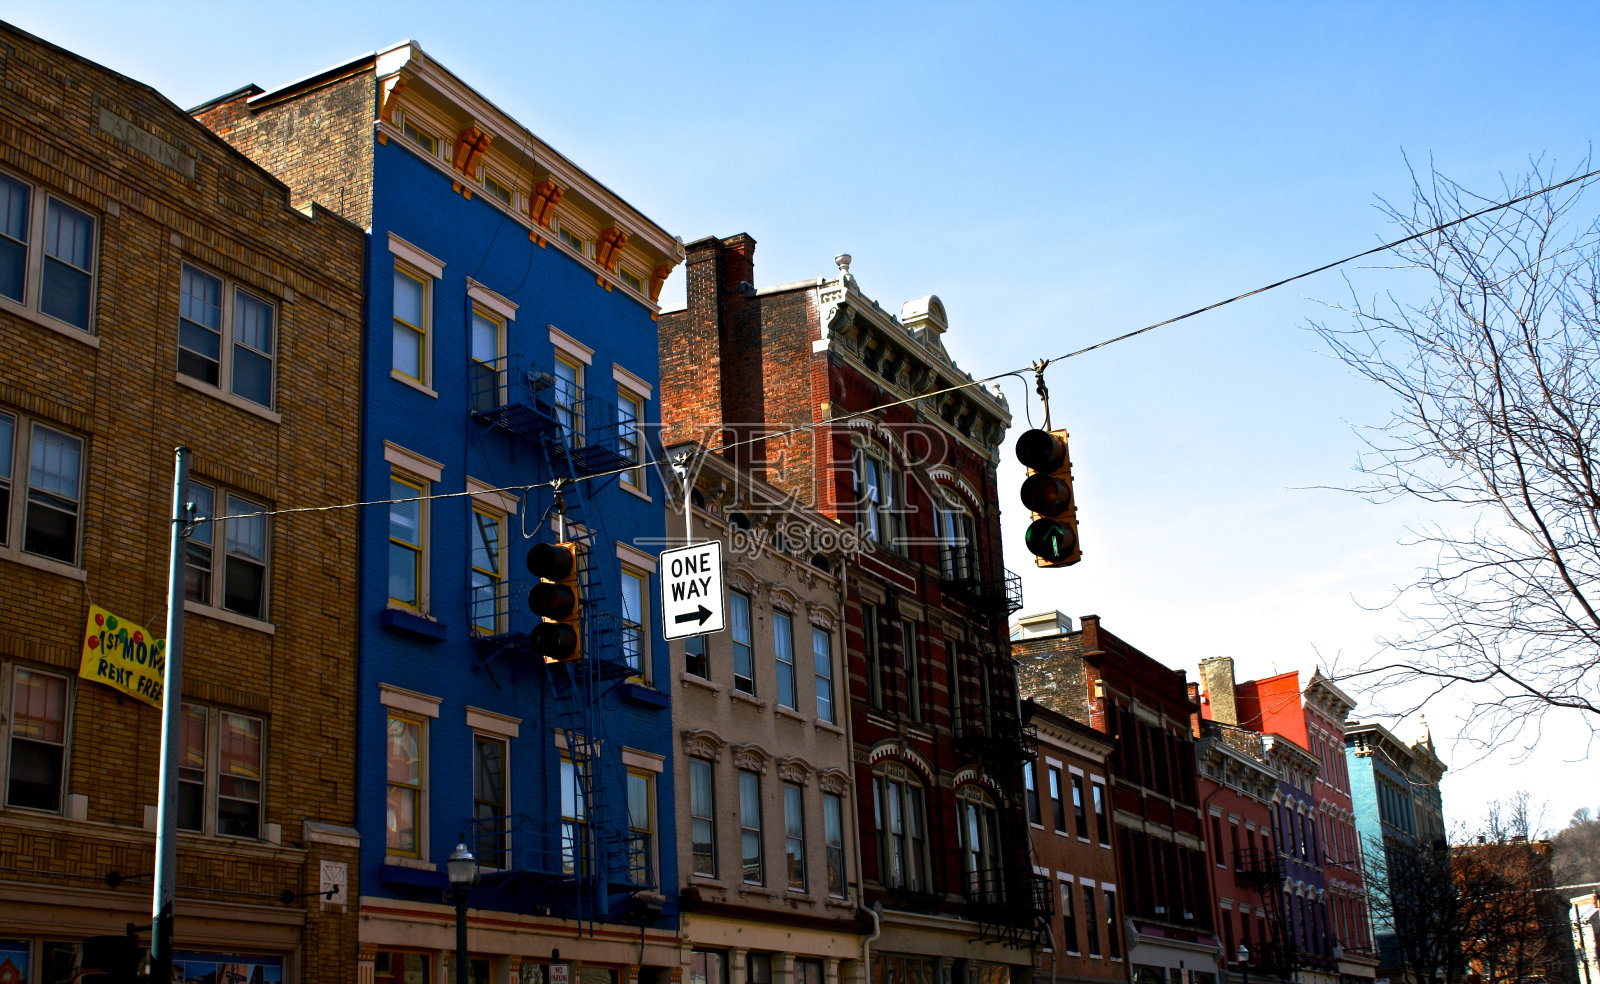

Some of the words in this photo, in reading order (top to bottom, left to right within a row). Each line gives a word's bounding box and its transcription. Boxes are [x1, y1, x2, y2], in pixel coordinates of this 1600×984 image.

[671, 552, 711, 578] ONE
[671, 576, 712, 602] WAY
[99, 631, 120, 654] 1ST
[97, 658, 134, 688] RENT
[136, 675, 164, 701] FREE
[551, 974, 568, 982] PARKING
